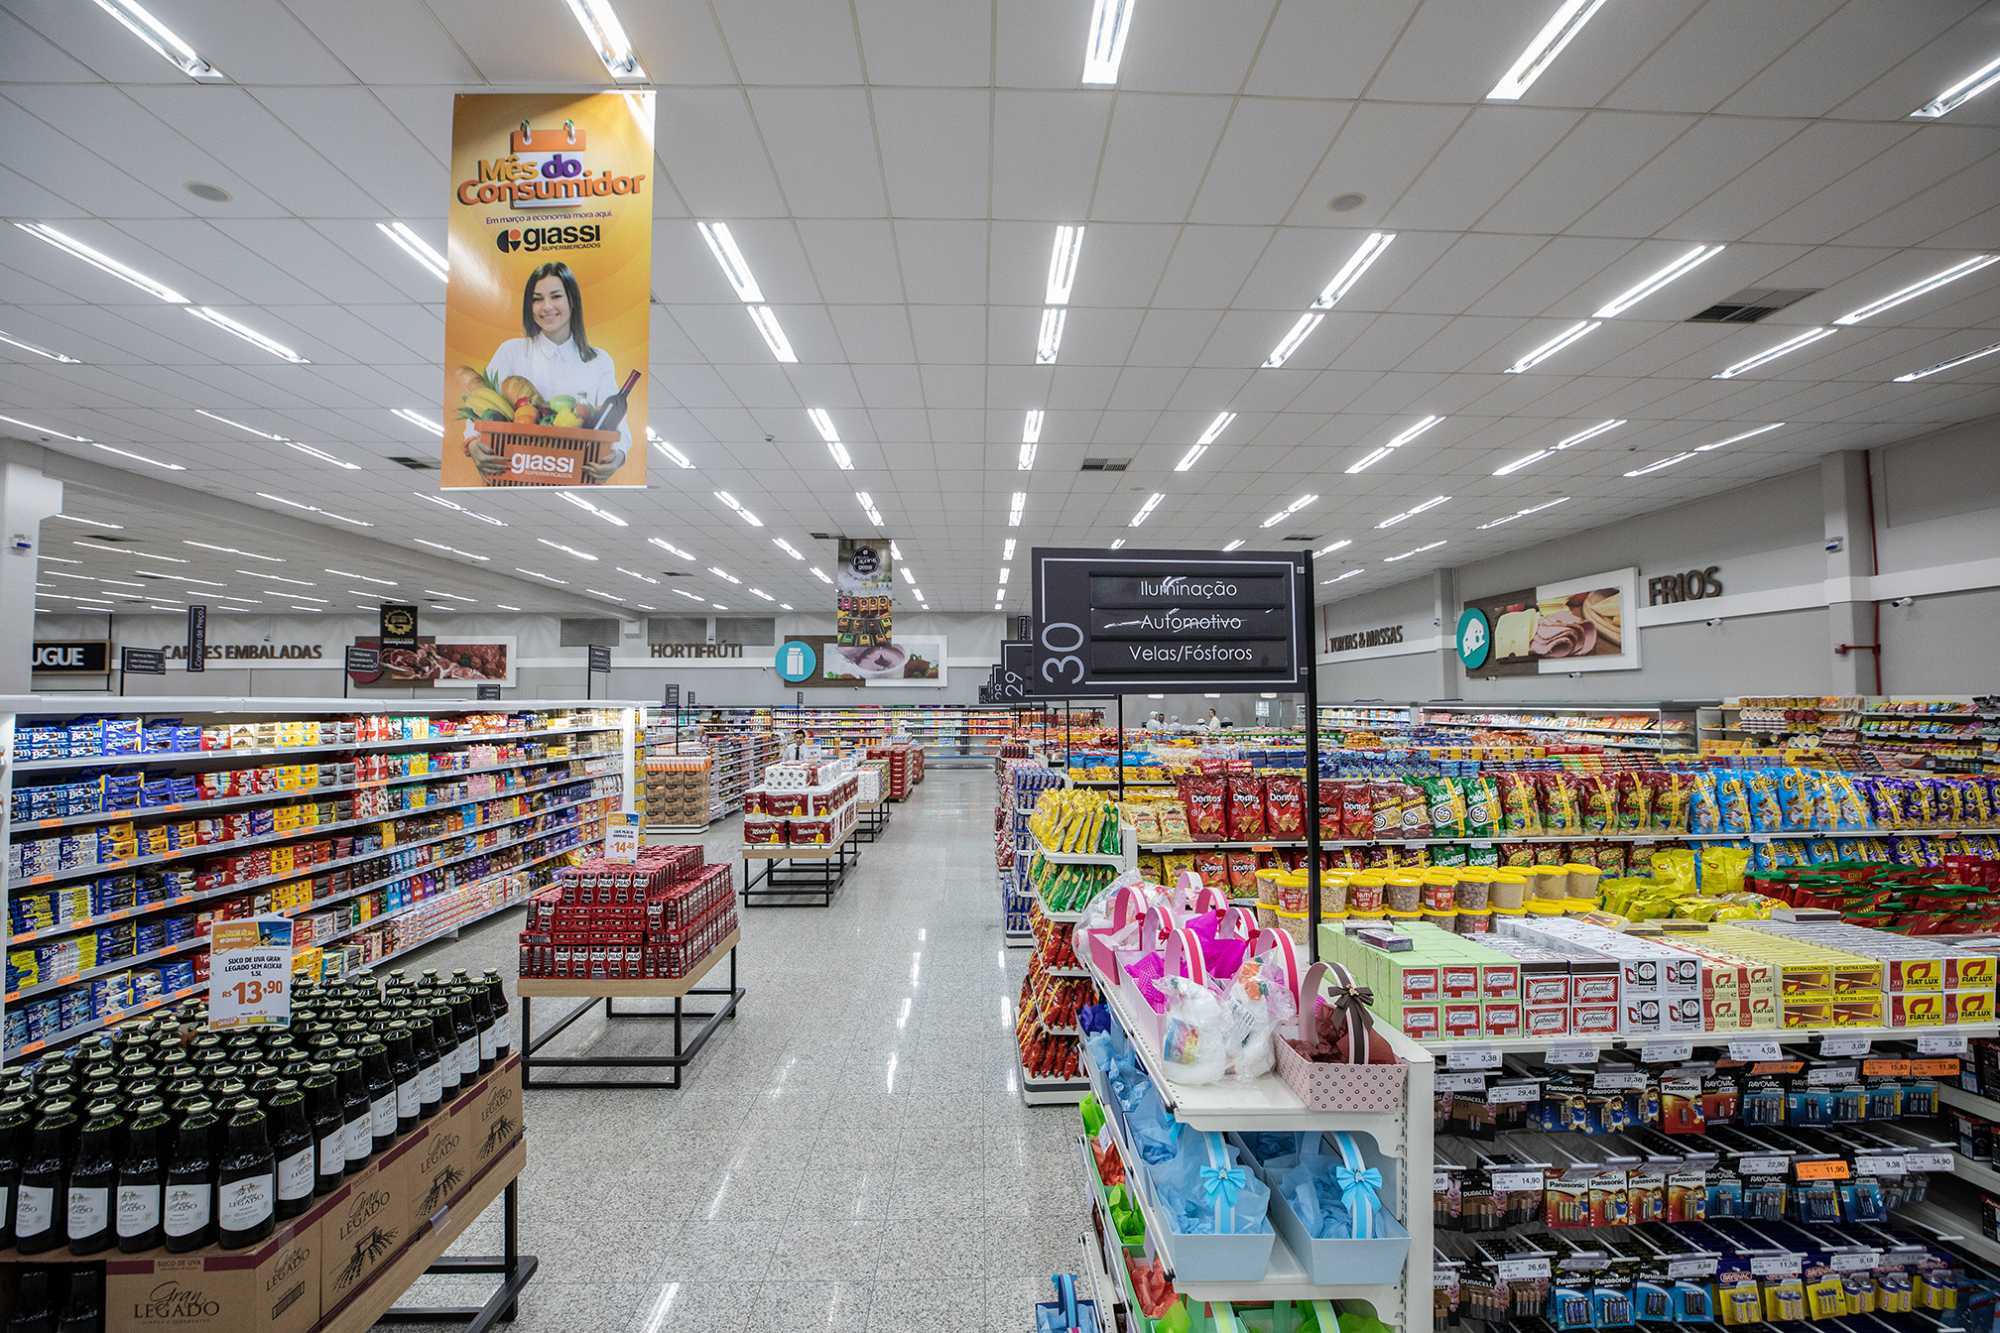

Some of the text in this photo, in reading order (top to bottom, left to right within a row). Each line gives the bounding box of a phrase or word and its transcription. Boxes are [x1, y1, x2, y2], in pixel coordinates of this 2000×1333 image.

[478, 152, 583, 184] Mês do
[457, 170, 647, 206] Consumidor
[486, 216, 499, 225] Em
[500, 214, 526, 225] março
[532, 212, 572, 222] economia
[573, 211, 594, 219] mora
[594, 209, 613, 219] aqui.
[523, 225, 601, 252] giassi
[541, 242, 602, 252] SUPERMERCADOS
[511, 453, 575, 474] giassi
[1140, 580, 1238, 599] Iluminação
[1648, 566, 1722, 607] FRIOS
[1140, 614, 1242, 631] Automotivo
[1329, 633, 1358, 653] TORTAS
[1366, 625, 1403, 647] MASSAS
[225, 645, 323, 660] EMBALADAS
[651, 640, 743, 659] HORTIFRÚTI
[1041, 622, 1085, 685] 30
[1129, 644, 1253, 663] Velas/Fósforos
[1005, 671, 1023, 697] 29
[1191, 794, 1221, 803] Doritos
[1232, 793, 1260, 804] Doritos
[1269, 793, 1299, 802] Doritos
[1319, 806, 1337, 814] oritos
[1344, 801, 1370, 811] Doritos
[1200, 863, 1224, 873] Doritos
[1232, 864, 1256, 873] Doritos
[225, 964, 250, 972] LEGADO
[263, 962, 282, 970] AÇÚCAR
[232, 980, 283, 1005] 13,90
[1761, 1046, 1776, 1055] 4,08
[1463, 1077, 1482, 1085] 14,90
[1704, 1080, 1735, 1088] RAYOVAC
[1748, 1080, 1780, 1088] RAYOVAC
[1546, 1084, 1584, 1093] Panasonic
[1587, 1087, 1622, 1095] Panasonic
[1454, 1094, 1485, 1104] DURACELL
[481, 1089, 512, 1121] LEGADO
[420, 1135, 460, 1174] LEGADO
[1631, 1177, 1662, 1186] Panasonic
[1671, 1175, 1703, 1183] Panasonic
[1750, 1175, 1782, 1183] RAYOVAC
[1550, 1181, 1585, 1189] Panasonic
[1463, 1189, 1492, 1197] DURACELL
[229, 1193, 265, 1208] LEGADO
[339, 1191, 390, 1241] LEGADO
[157, 1260, 175, 1268] SUCO
[1527, 1264, 1548, 1272] 26,68
[266, 1248, 310, 1292] LEGADO
[1460, 1279, 1494, 1288] DURACELL
[1556, 1276, 1590, 1285] Panasonic
[1595, 1276, 1631, 1285] Panasonic
[149, 1280, 206, 1310] Gran
[133, 1300, 220, 1319] LEGADO
